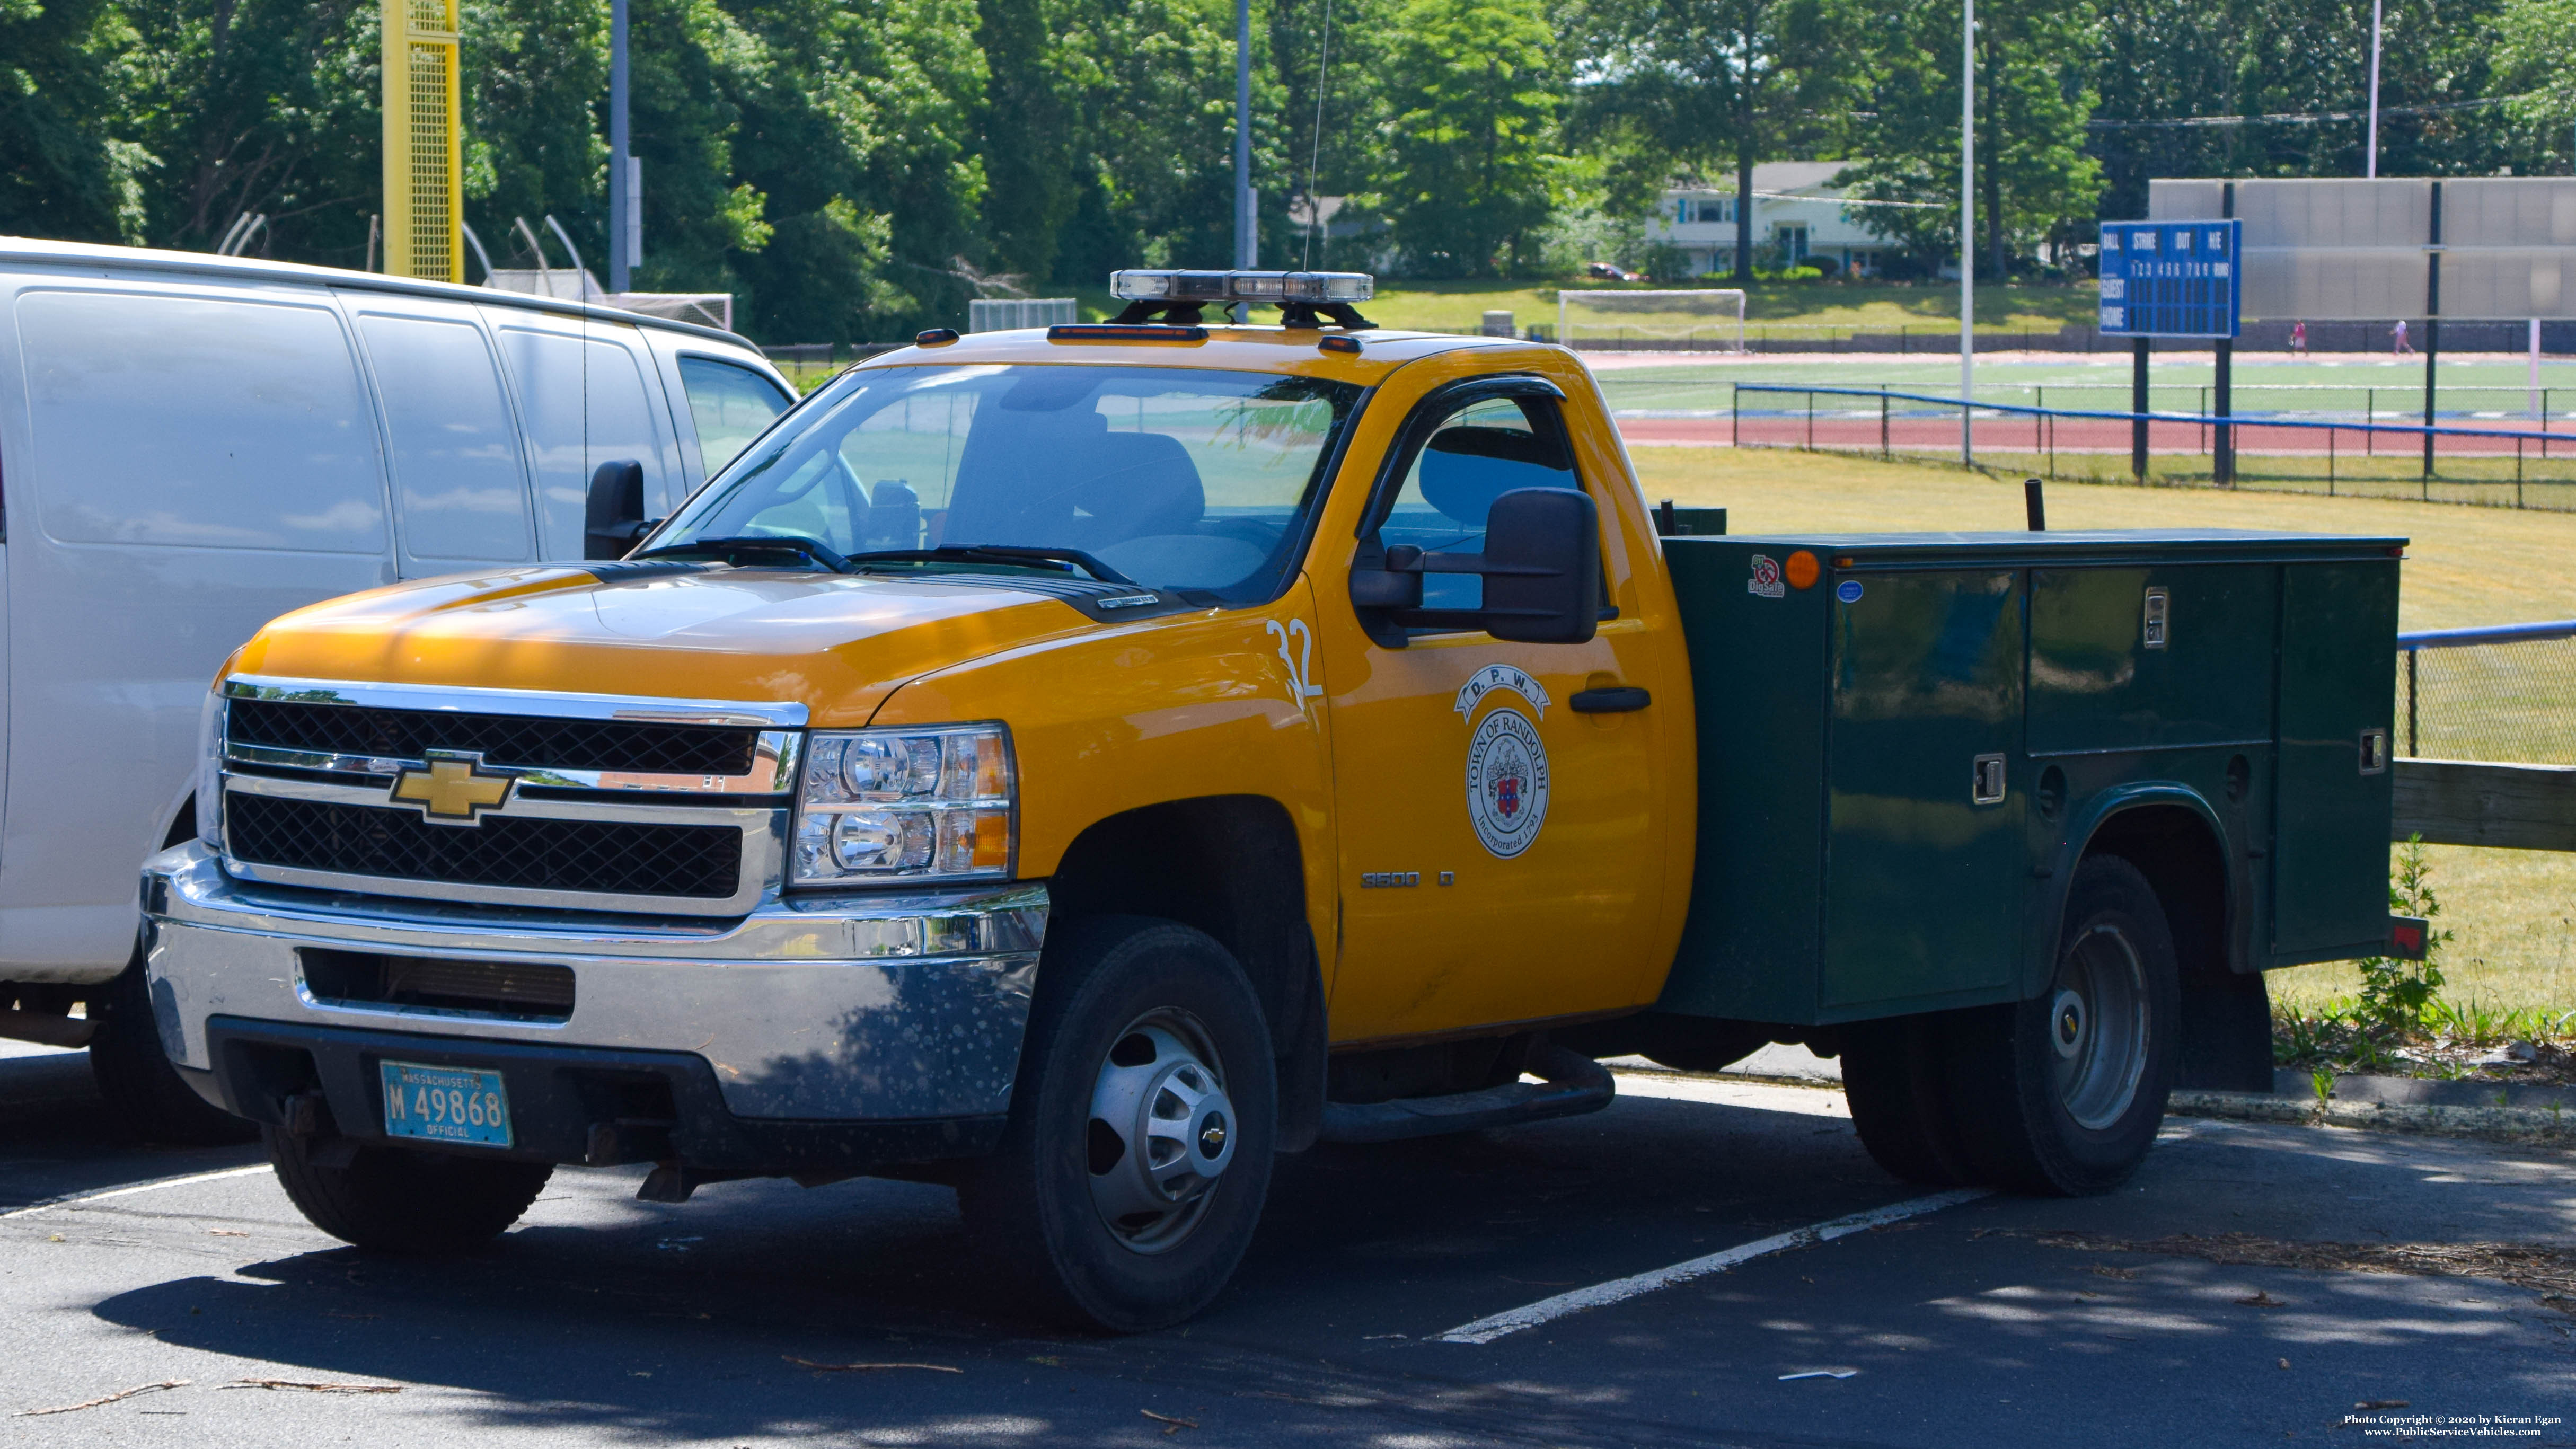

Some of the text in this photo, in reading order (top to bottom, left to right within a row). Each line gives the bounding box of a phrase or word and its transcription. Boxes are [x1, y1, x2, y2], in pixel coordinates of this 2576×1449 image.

[2103, 232, 2119, 250] BALL
[2132, 232, 2156, 250] STRIKE
[2175, 232, 2190, 250] OUT
[2102, 279, 2124, 299] GUEST
[2102, 306, 2124, 327] HOME
[1750, 581, 1783, 593] DigSafe
[1266, 619, 1323, 712] 32
[1490, 669, 1504, 683] P.
[1513, 672, 1528, 693] W.
[1470, 717, 1546, 792] TOWN OF RANDOLPH
[1478, 814, 1539, 850] Incorporated 1793
[1361, 872, 1421, 888] 3500
[402, 1073, 482, 1090] MASSACHUSETTS
[389, 1084, 502, 1128] M 49868
[426, 1124, 470, 1138] OFFICIAL
